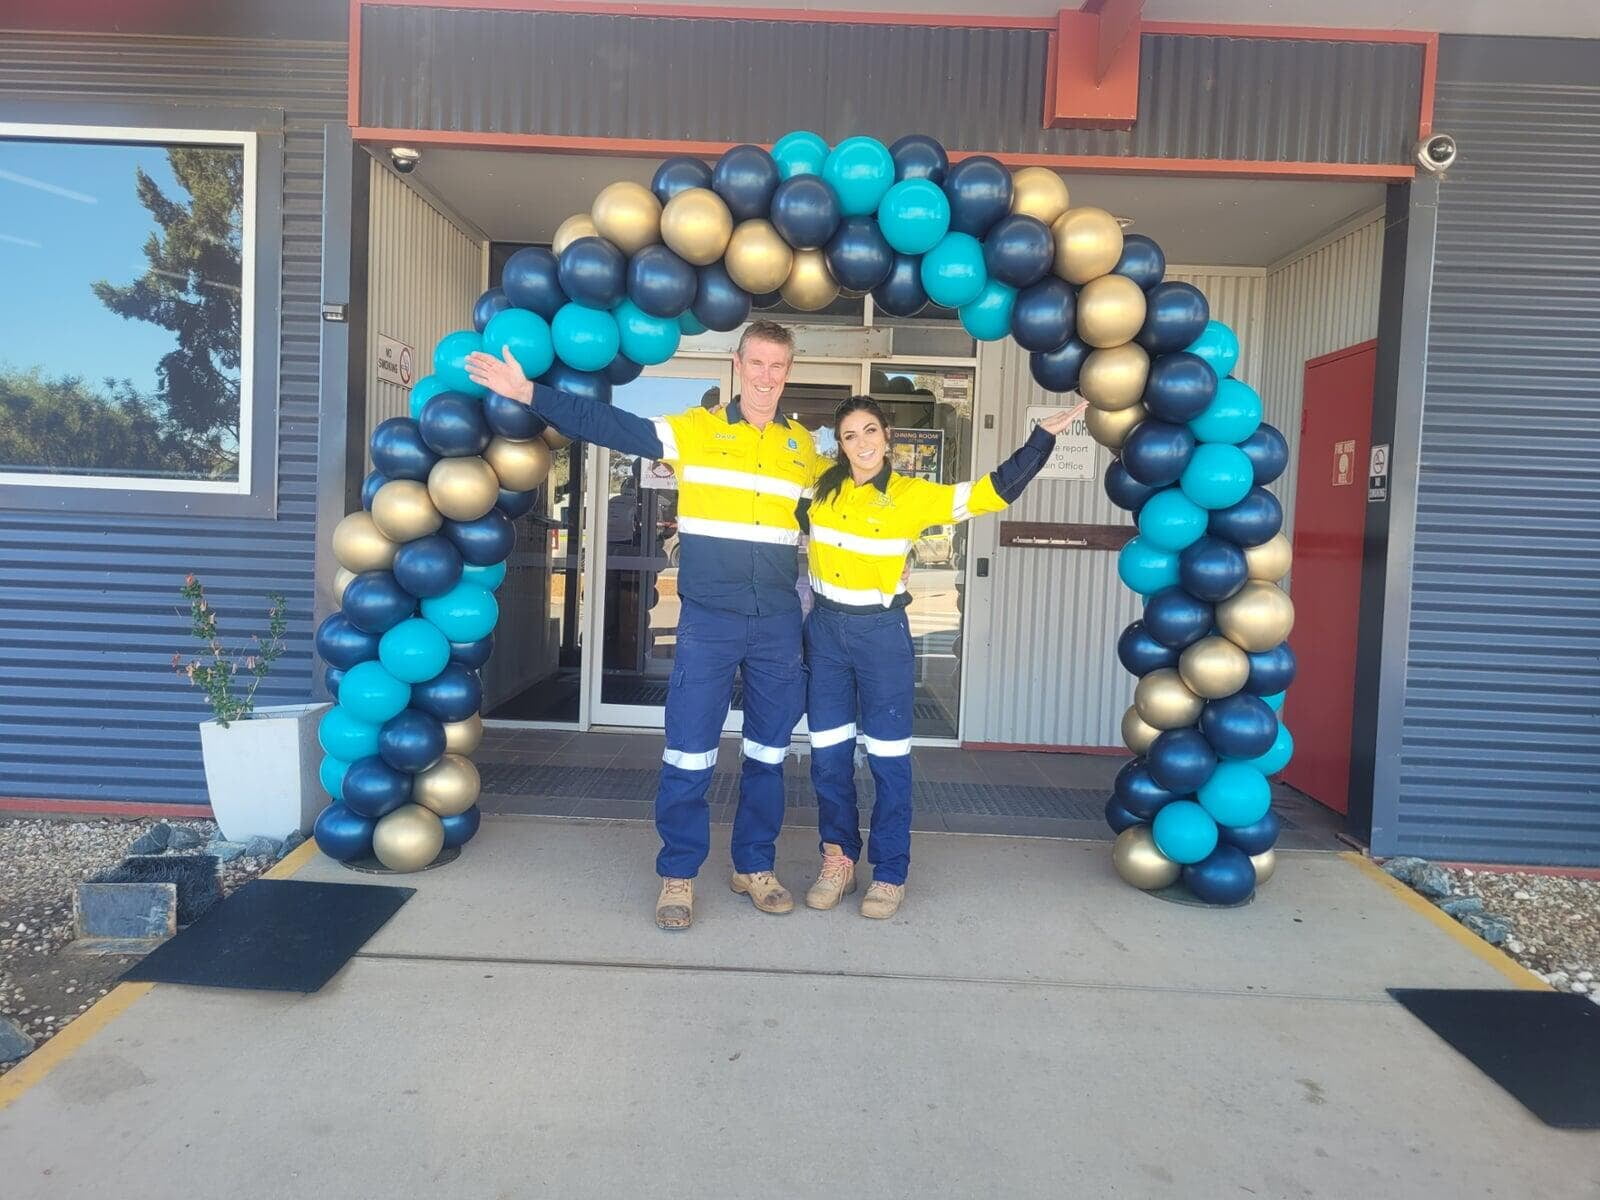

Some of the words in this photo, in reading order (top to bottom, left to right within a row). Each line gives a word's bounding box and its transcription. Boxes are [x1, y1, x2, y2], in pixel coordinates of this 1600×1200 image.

[385, 348, 393, 358] NO
[377, 358, 398, 374] SMOKING
[1062, 445, 1088, 453] report
[1058, 461, 1084, 470] Office
